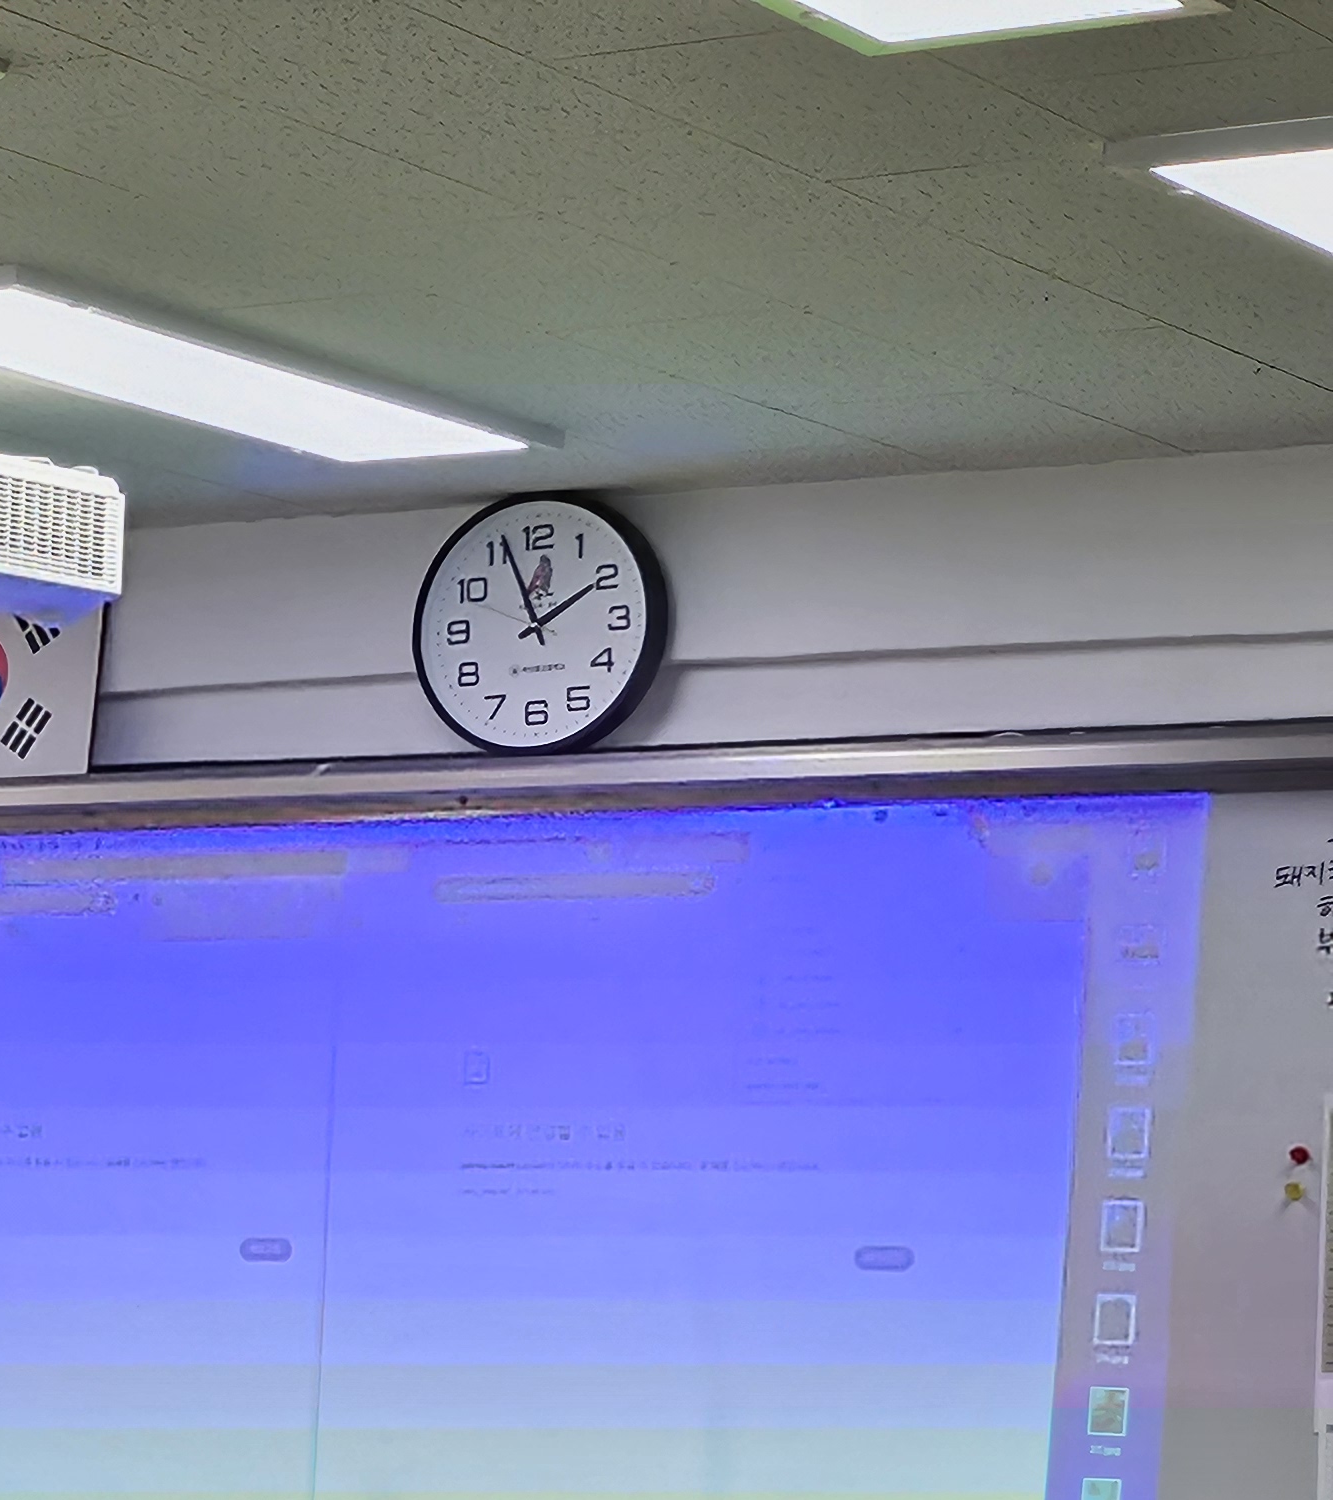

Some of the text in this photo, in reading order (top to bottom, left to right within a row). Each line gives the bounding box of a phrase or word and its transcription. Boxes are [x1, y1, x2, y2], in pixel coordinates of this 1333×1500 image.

[522, 523, 555, 551] 12
[574, 533, 585, 560] 1
[457, 577, 488, 603] 10
[595, 564, 619, 590] 2
[607, 605, 631, 630] 3
[446, 619, 470, 645] 9
[590, 647, 614, 672] 4
[457, 661, 480, 687] 8
[483, 694, 506, 720] 7
[566, 685, 590, 712] 5
[524, 700, 549, 726] 6
[1273, 860, 1333, 889] 돼지
